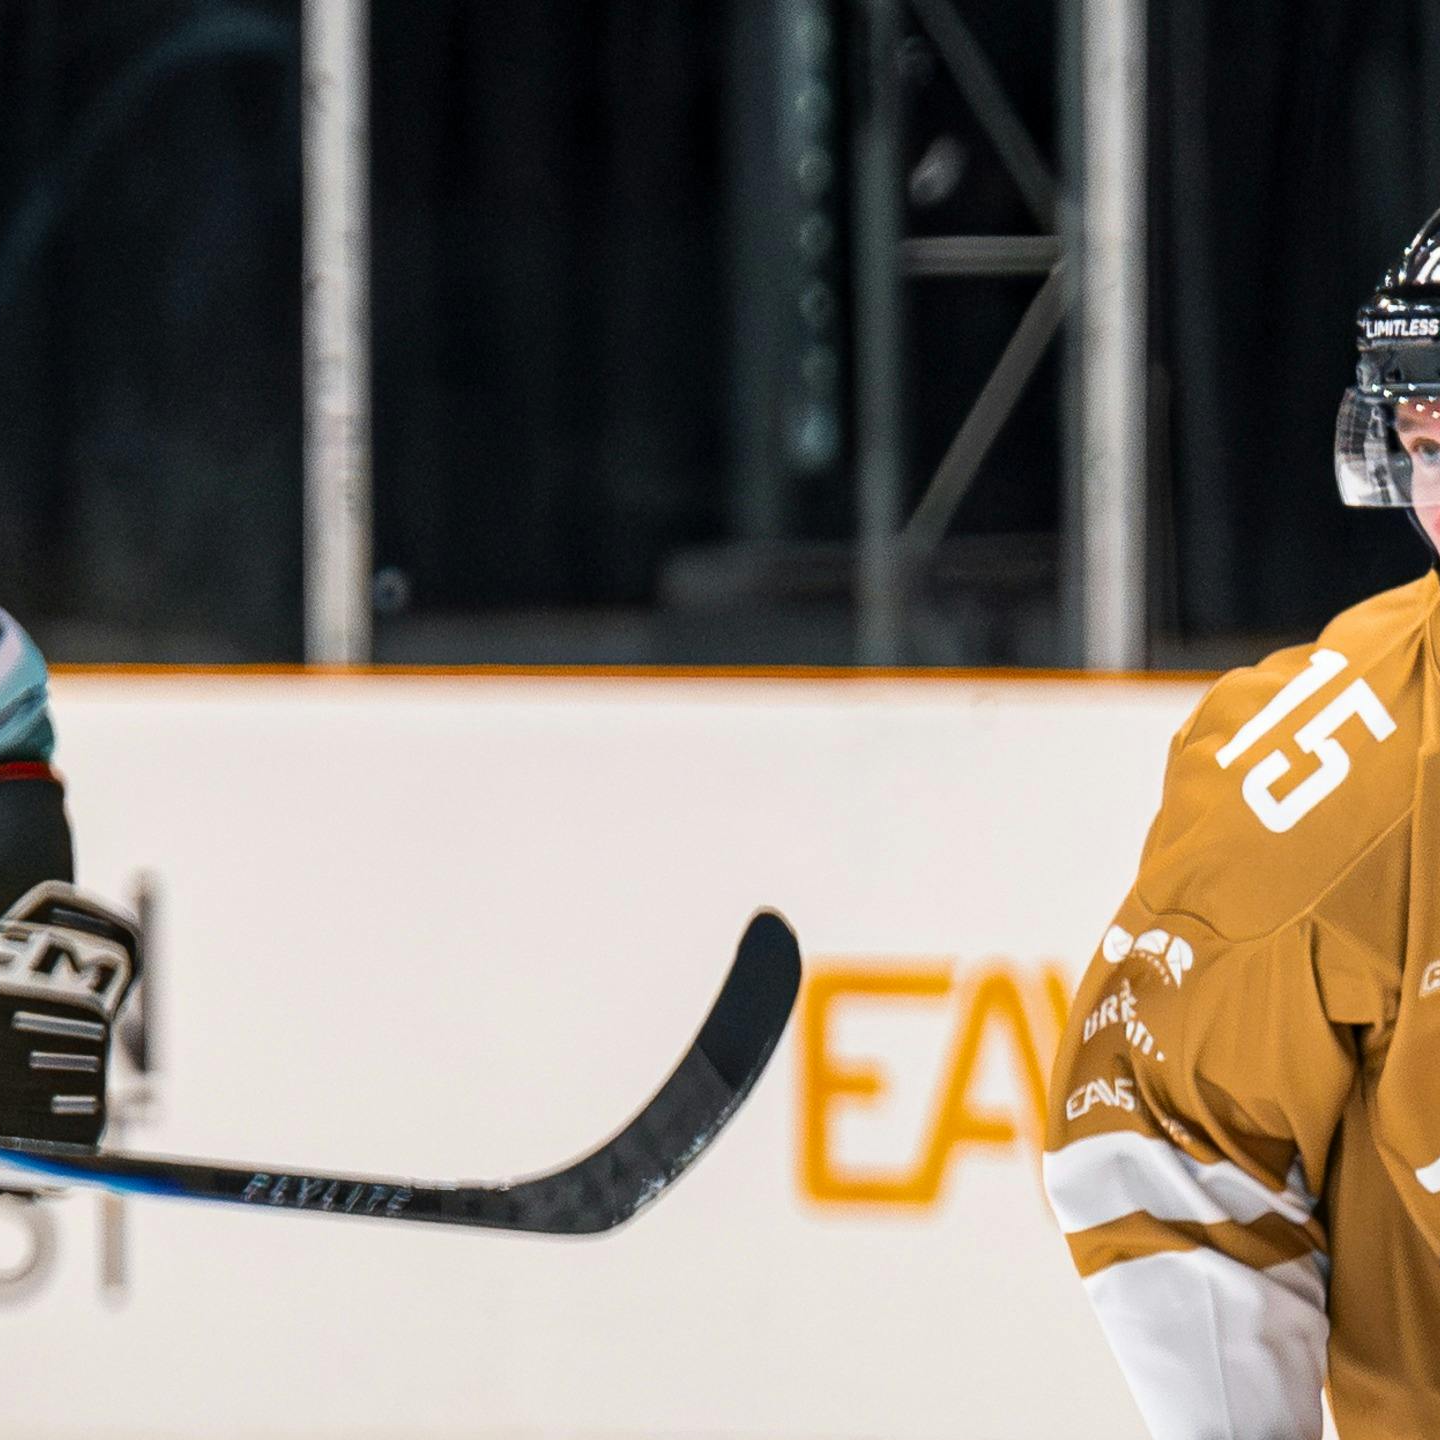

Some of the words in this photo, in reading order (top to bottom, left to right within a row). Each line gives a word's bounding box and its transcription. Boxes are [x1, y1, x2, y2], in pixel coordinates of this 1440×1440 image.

[1366, 317, 1440, 338] LIMITLESS
[1215, 648, 1398, 834] 15
[798, 958, 1073, 1208] EA
